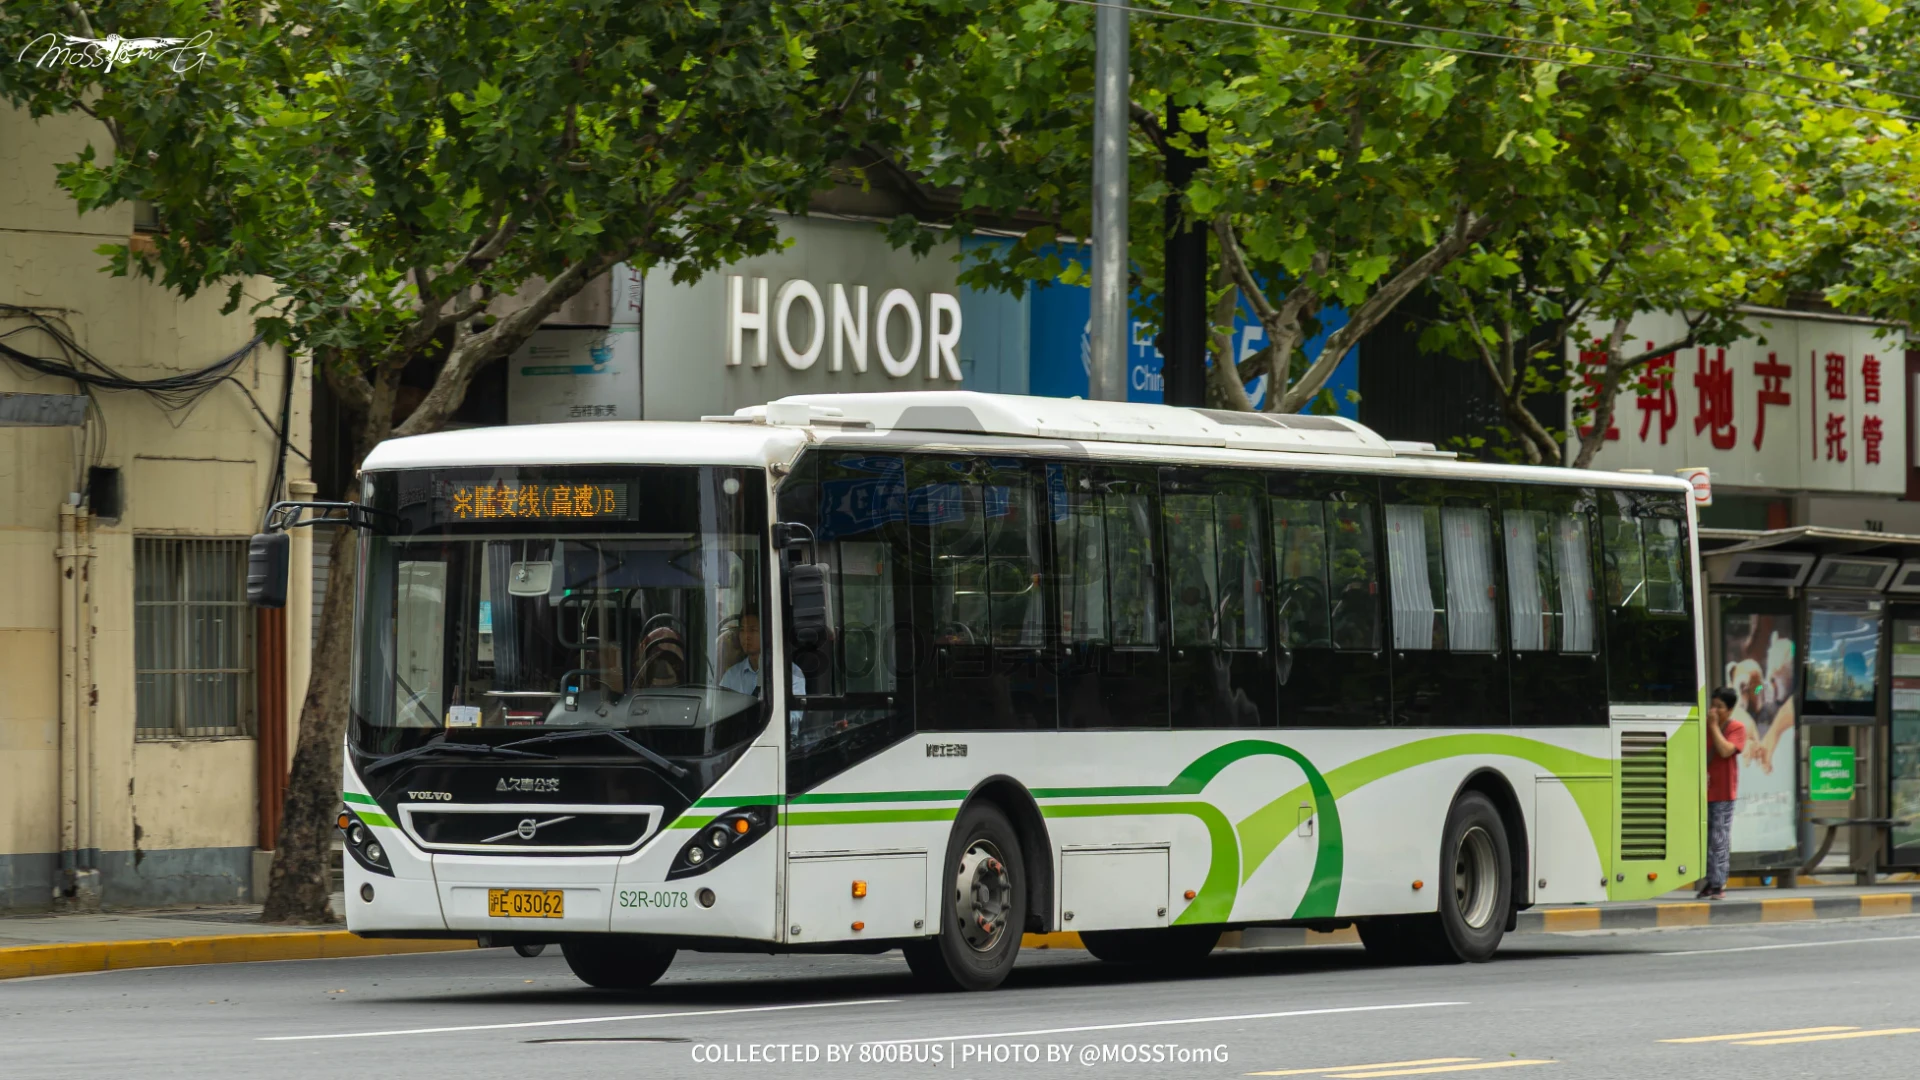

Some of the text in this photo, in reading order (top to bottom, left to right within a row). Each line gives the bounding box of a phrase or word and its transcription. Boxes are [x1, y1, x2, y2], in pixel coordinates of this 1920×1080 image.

[726, 275, 963, 381] HONOR
[1132, 364, 1164, 392] Chin
[408, 791, 452, 801] VOLVO
[619, 891, 689, 908] S2R-0078
